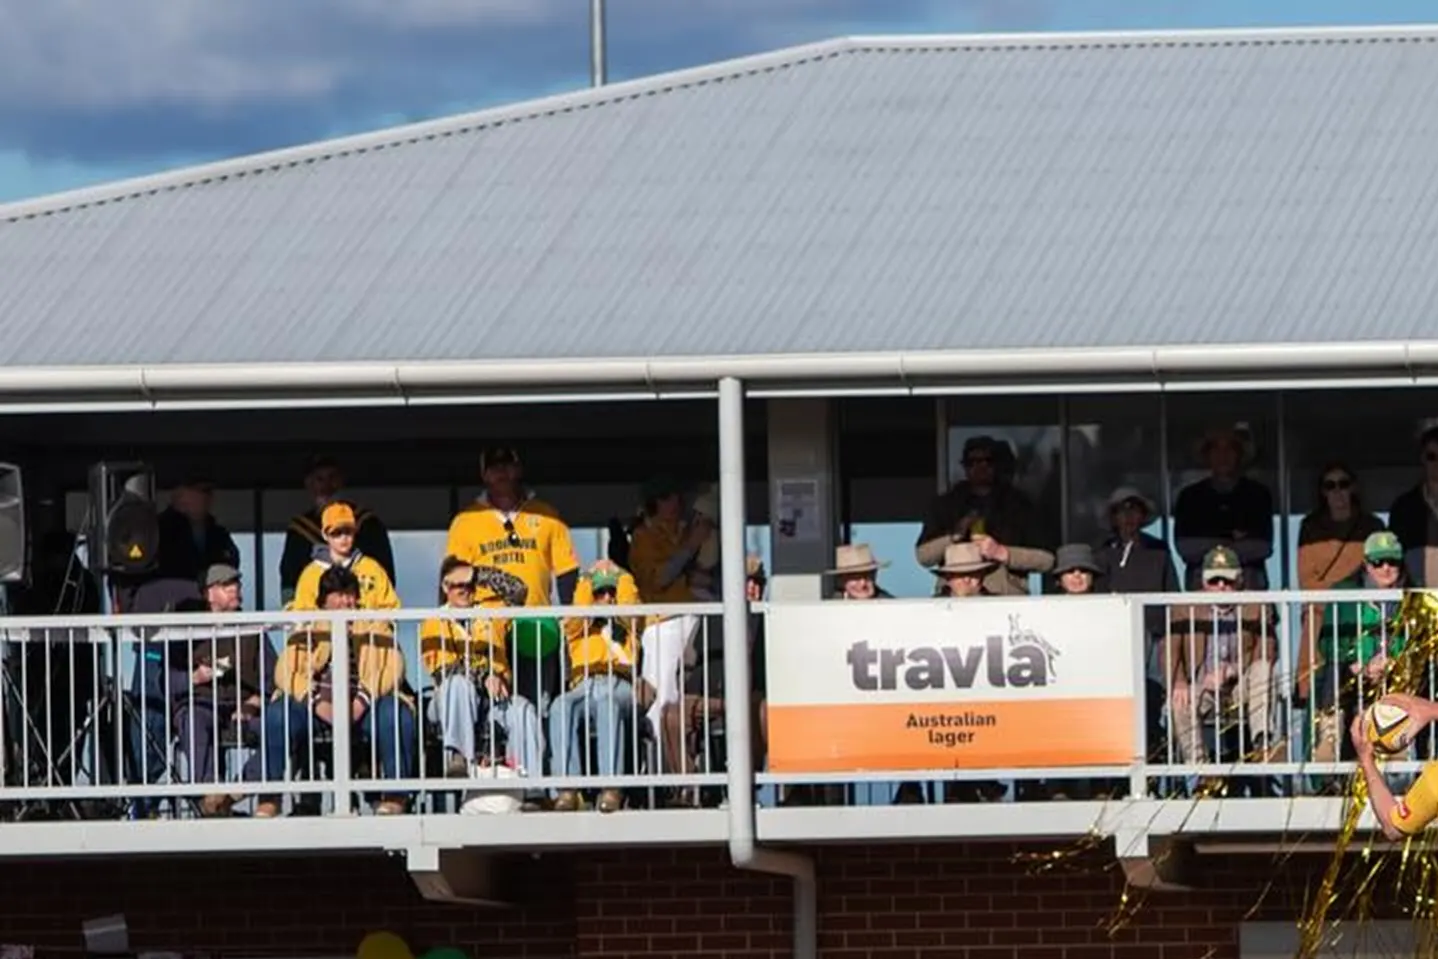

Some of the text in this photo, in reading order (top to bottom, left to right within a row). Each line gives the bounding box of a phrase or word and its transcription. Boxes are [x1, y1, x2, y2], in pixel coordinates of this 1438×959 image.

[846, 636, 1048, 691] travla
[906, 713, 996, 729] Australian
[928, 730, 975, 747] lager
